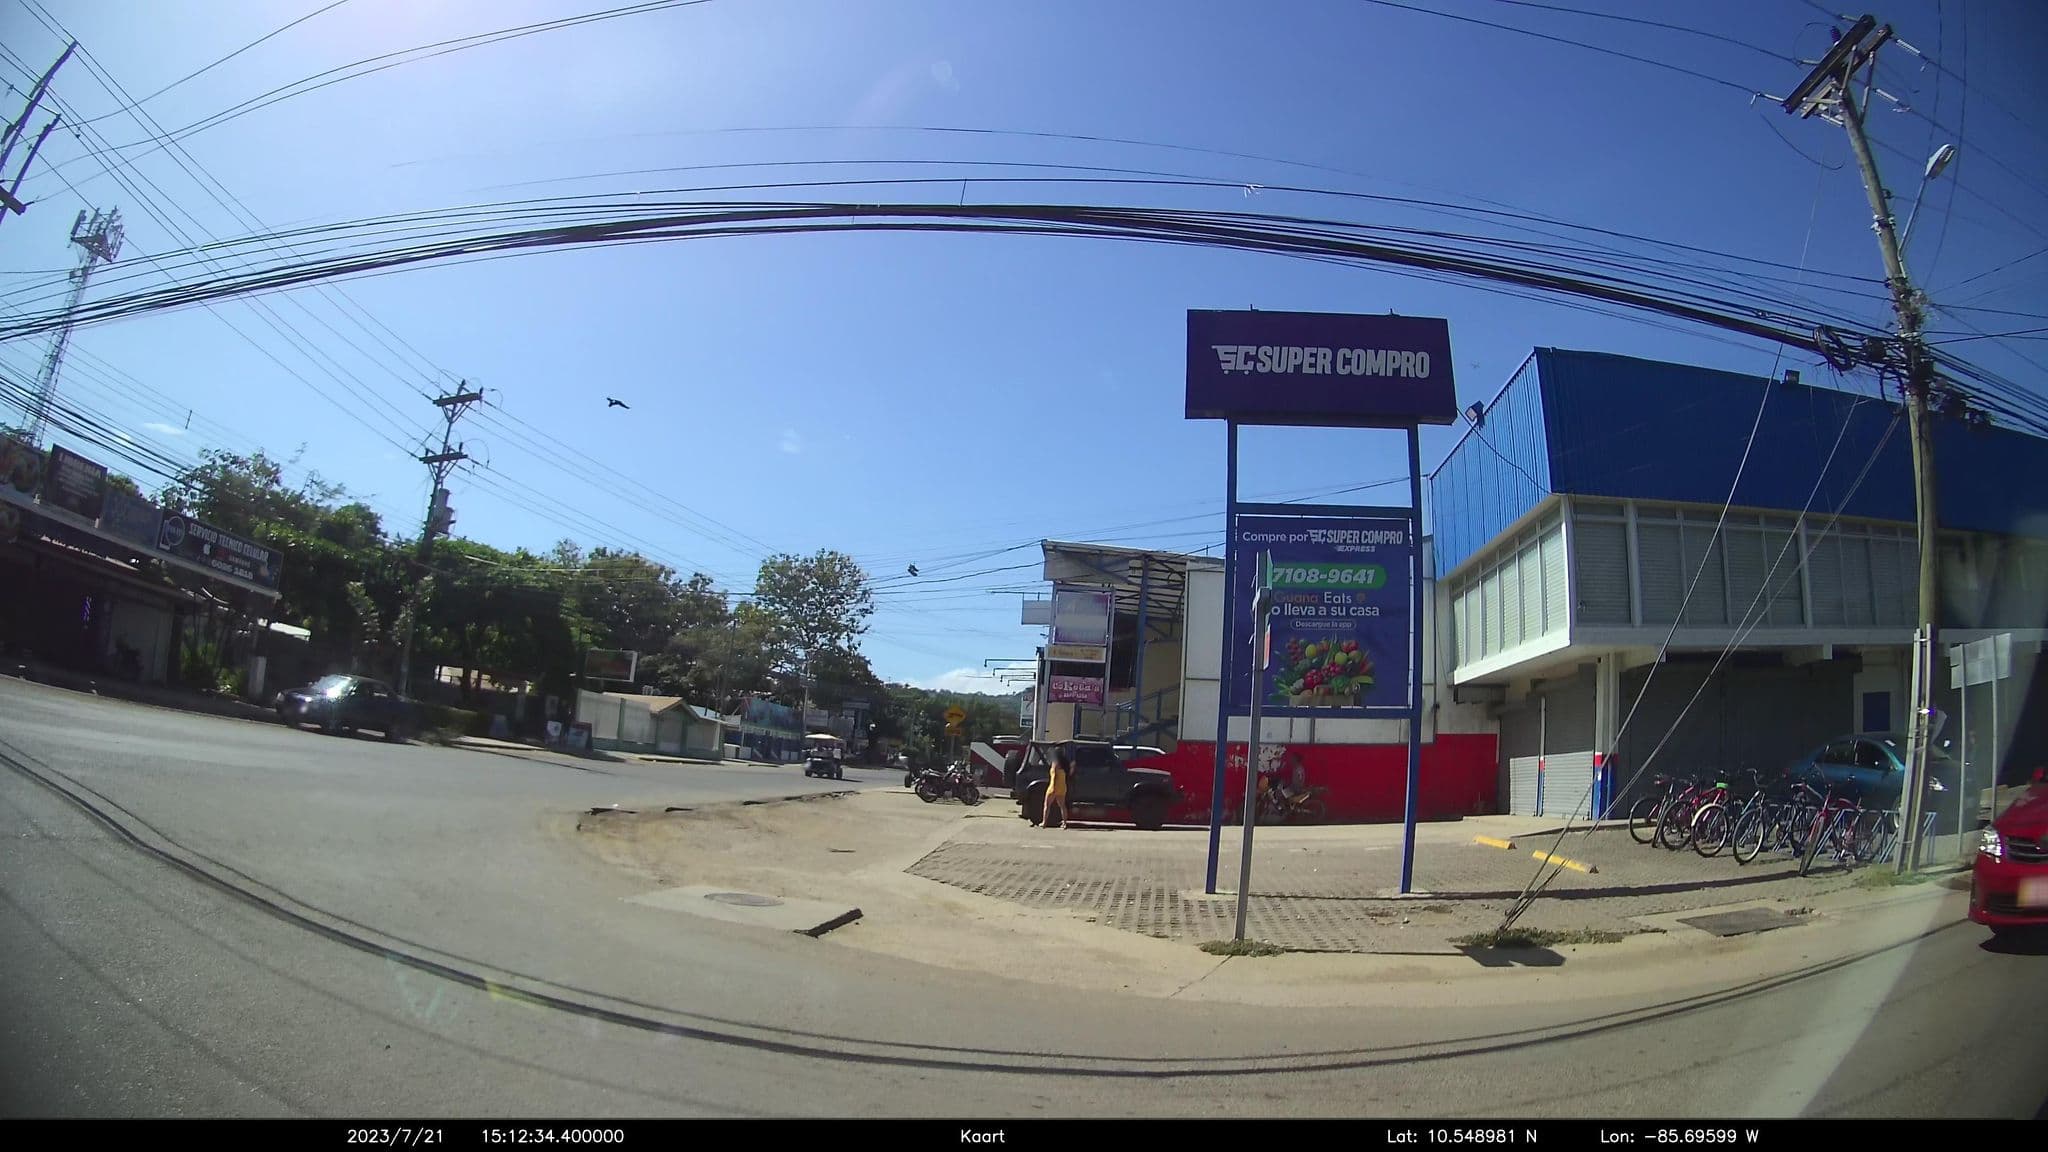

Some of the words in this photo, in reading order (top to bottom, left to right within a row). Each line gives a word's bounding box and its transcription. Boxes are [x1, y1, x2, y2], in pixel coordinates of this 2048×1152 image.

[1256, 345, 1332, 375] SUPER
[1336, 348, 1430, 378] COMPRO
[189, 523, 218, 543] SERVICIO
[1242, 531, 1287, 543] Compre
[1289, 533, 1309, 543] por
[1327, 530, 1360, 544] SUPER
[1361, 530, 1403, 545] COMPRO
[1273, 568, 1375, 584] 7108-9641
[1324, 592, 1352, 604] Eats
[1284, 603, 1316, 616] lleva
[1318, 606, 1326, 616] a
[1331, 606, 1346, 616] su
[1349, 606, 1380, 616] casa
